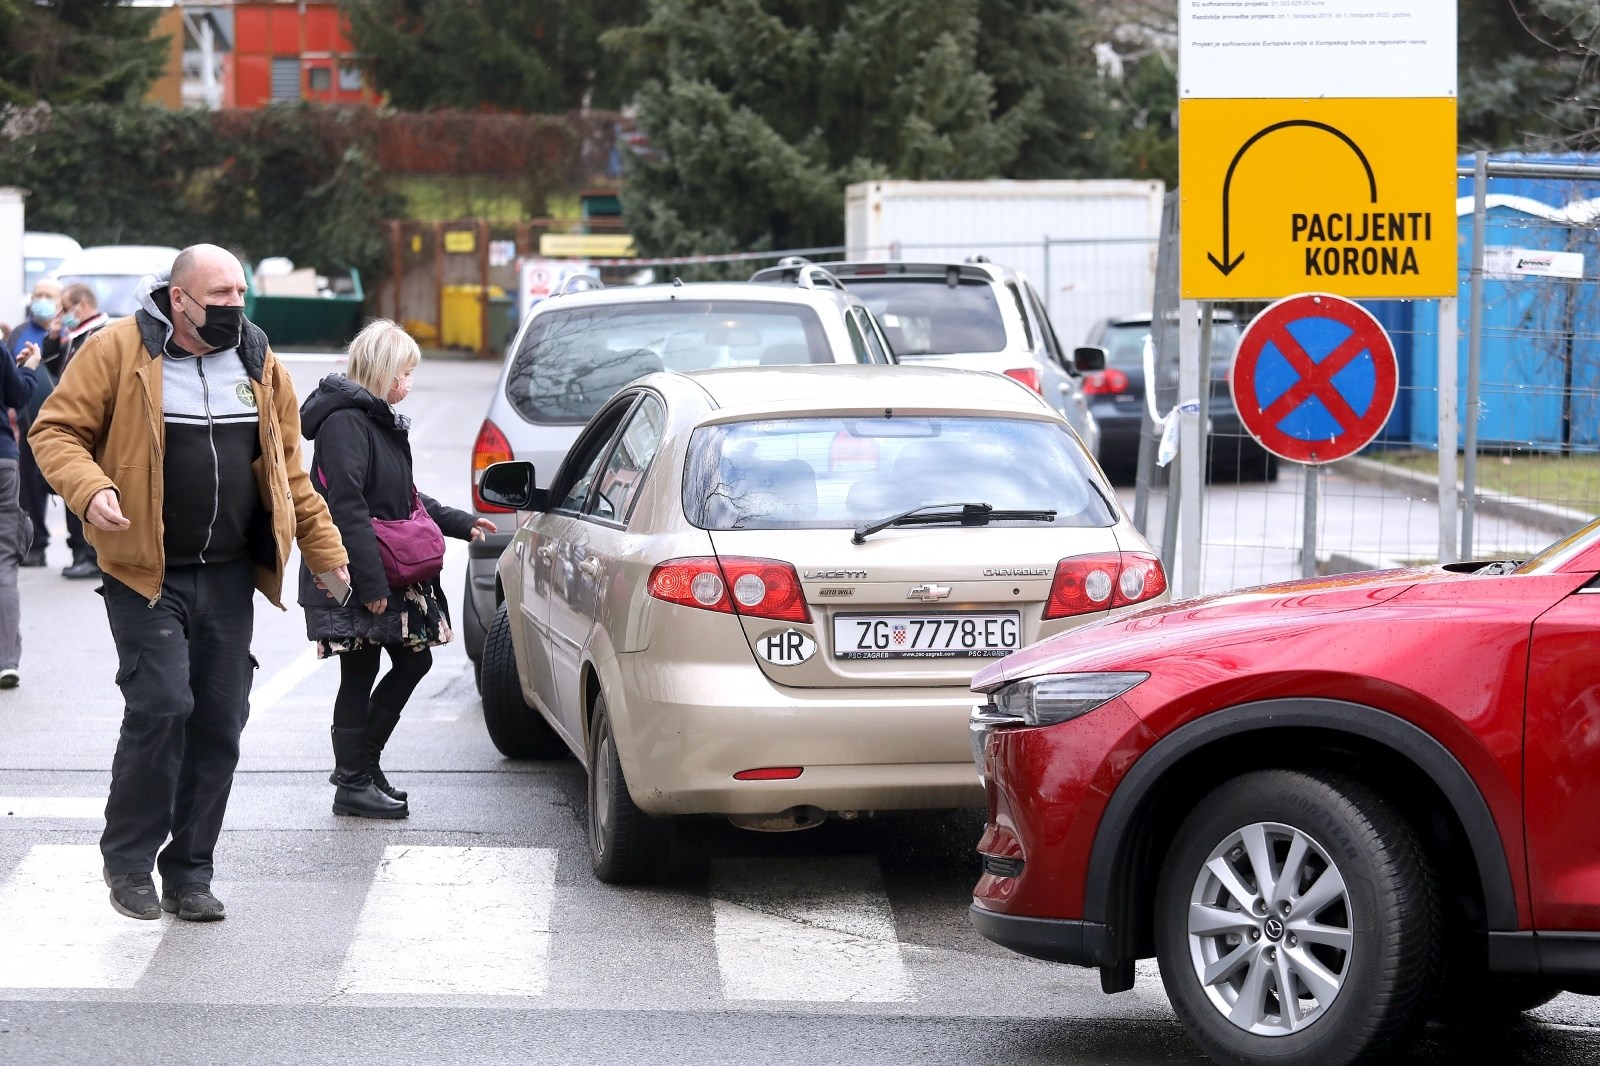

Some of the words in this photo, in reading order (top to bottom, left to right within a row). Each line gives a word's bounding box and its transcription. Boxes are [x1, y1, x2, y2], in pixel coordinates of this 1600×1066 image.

[1292, 212, 1431, 242] PACIJENTI
[1305, 247, 1420, 276] KORONA
[803, 569, 868, 579] LACETTI
[983, 568, 1050, 576] CHEVROLET
[767, 632, 805, 661] HR
[856, 620, 890, 649] ZG
[1278, 790, 1358, 860] GOODYEAR
